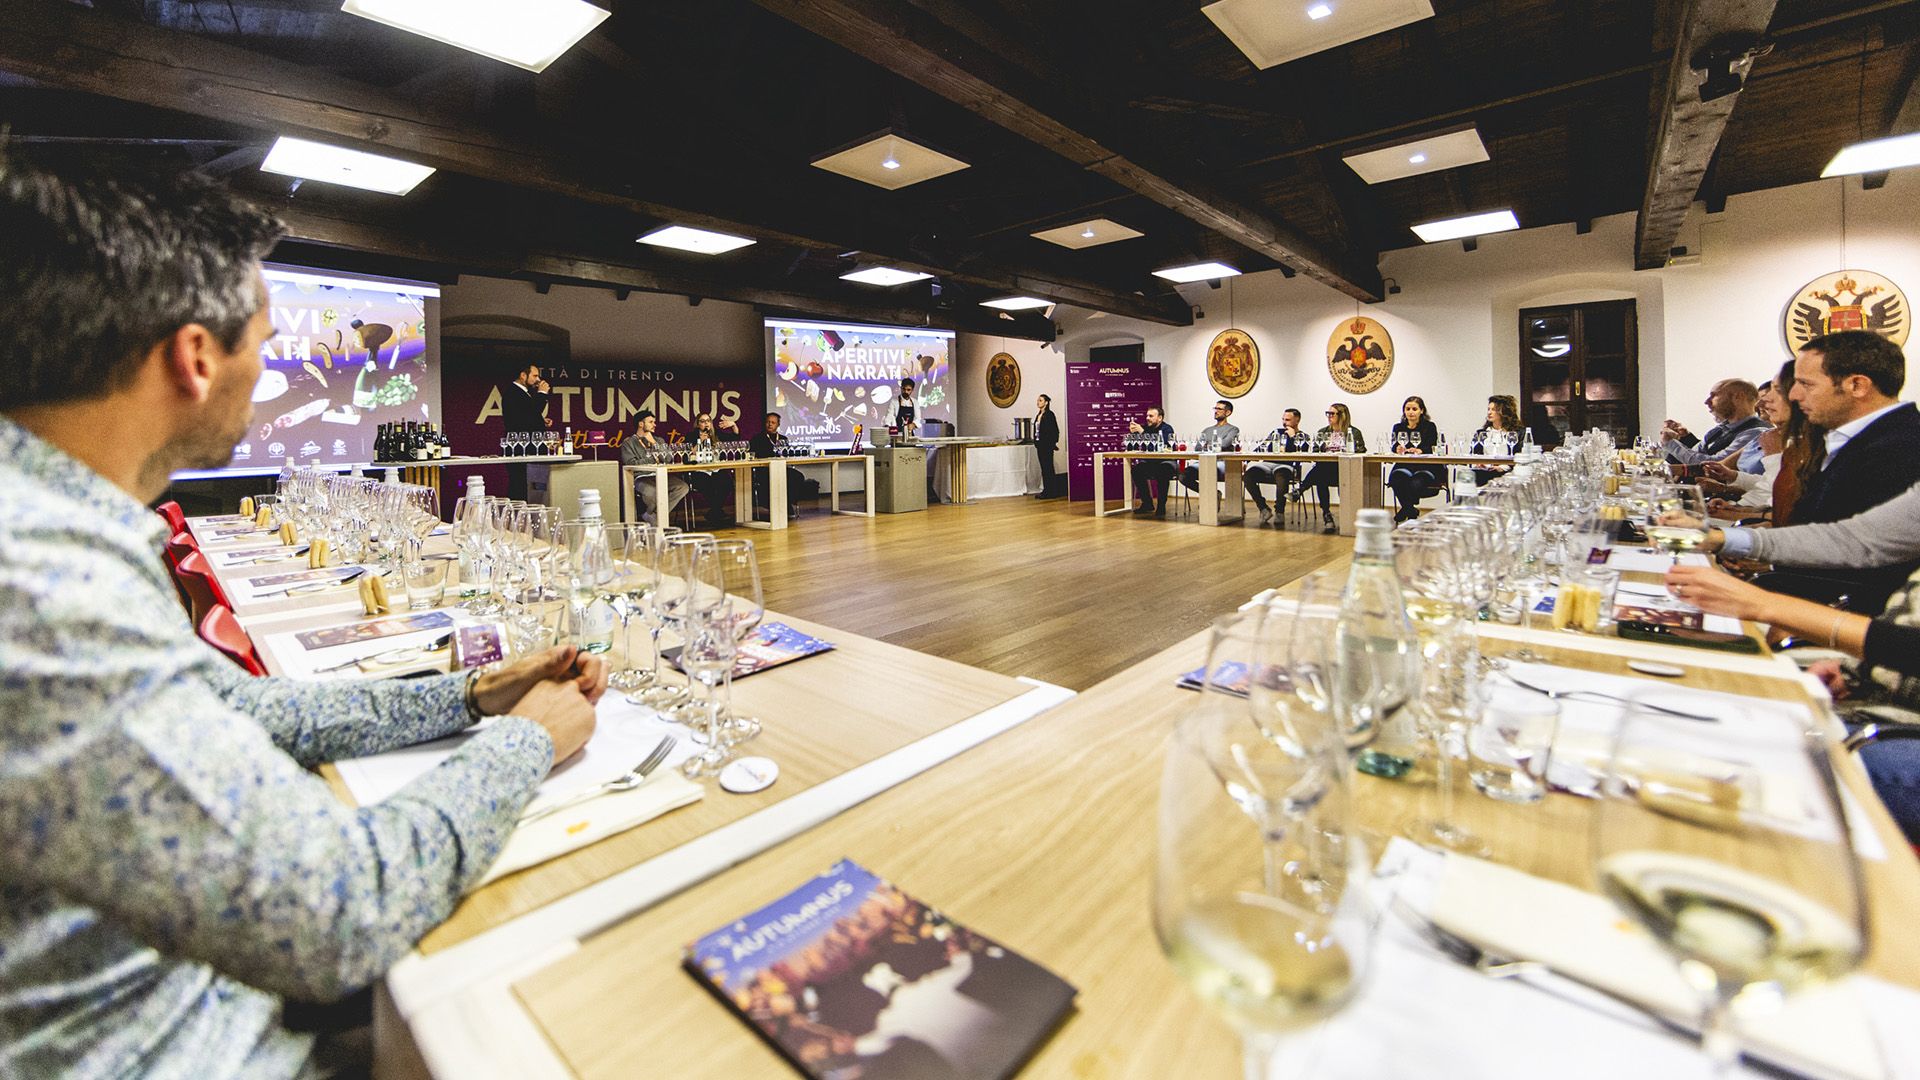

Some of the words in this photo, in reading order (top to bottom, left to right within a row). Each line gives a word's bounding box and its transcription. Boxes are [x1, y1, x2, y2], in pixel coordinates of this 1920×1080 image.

[821, 348, 905, 364] APERITIVI
[538, 364, 569, 379] TTÀ
[580, 368, 598, 380] DI
[608, 369, 675, 382] TRENTO
[828, 364, 901, 381] NARRATI
[475, 384, 741, 425] ATUMNUS
[785, 424, 842, 436] AUTUMNUS
[732, 880, 854, 962] AUTUMNUS
